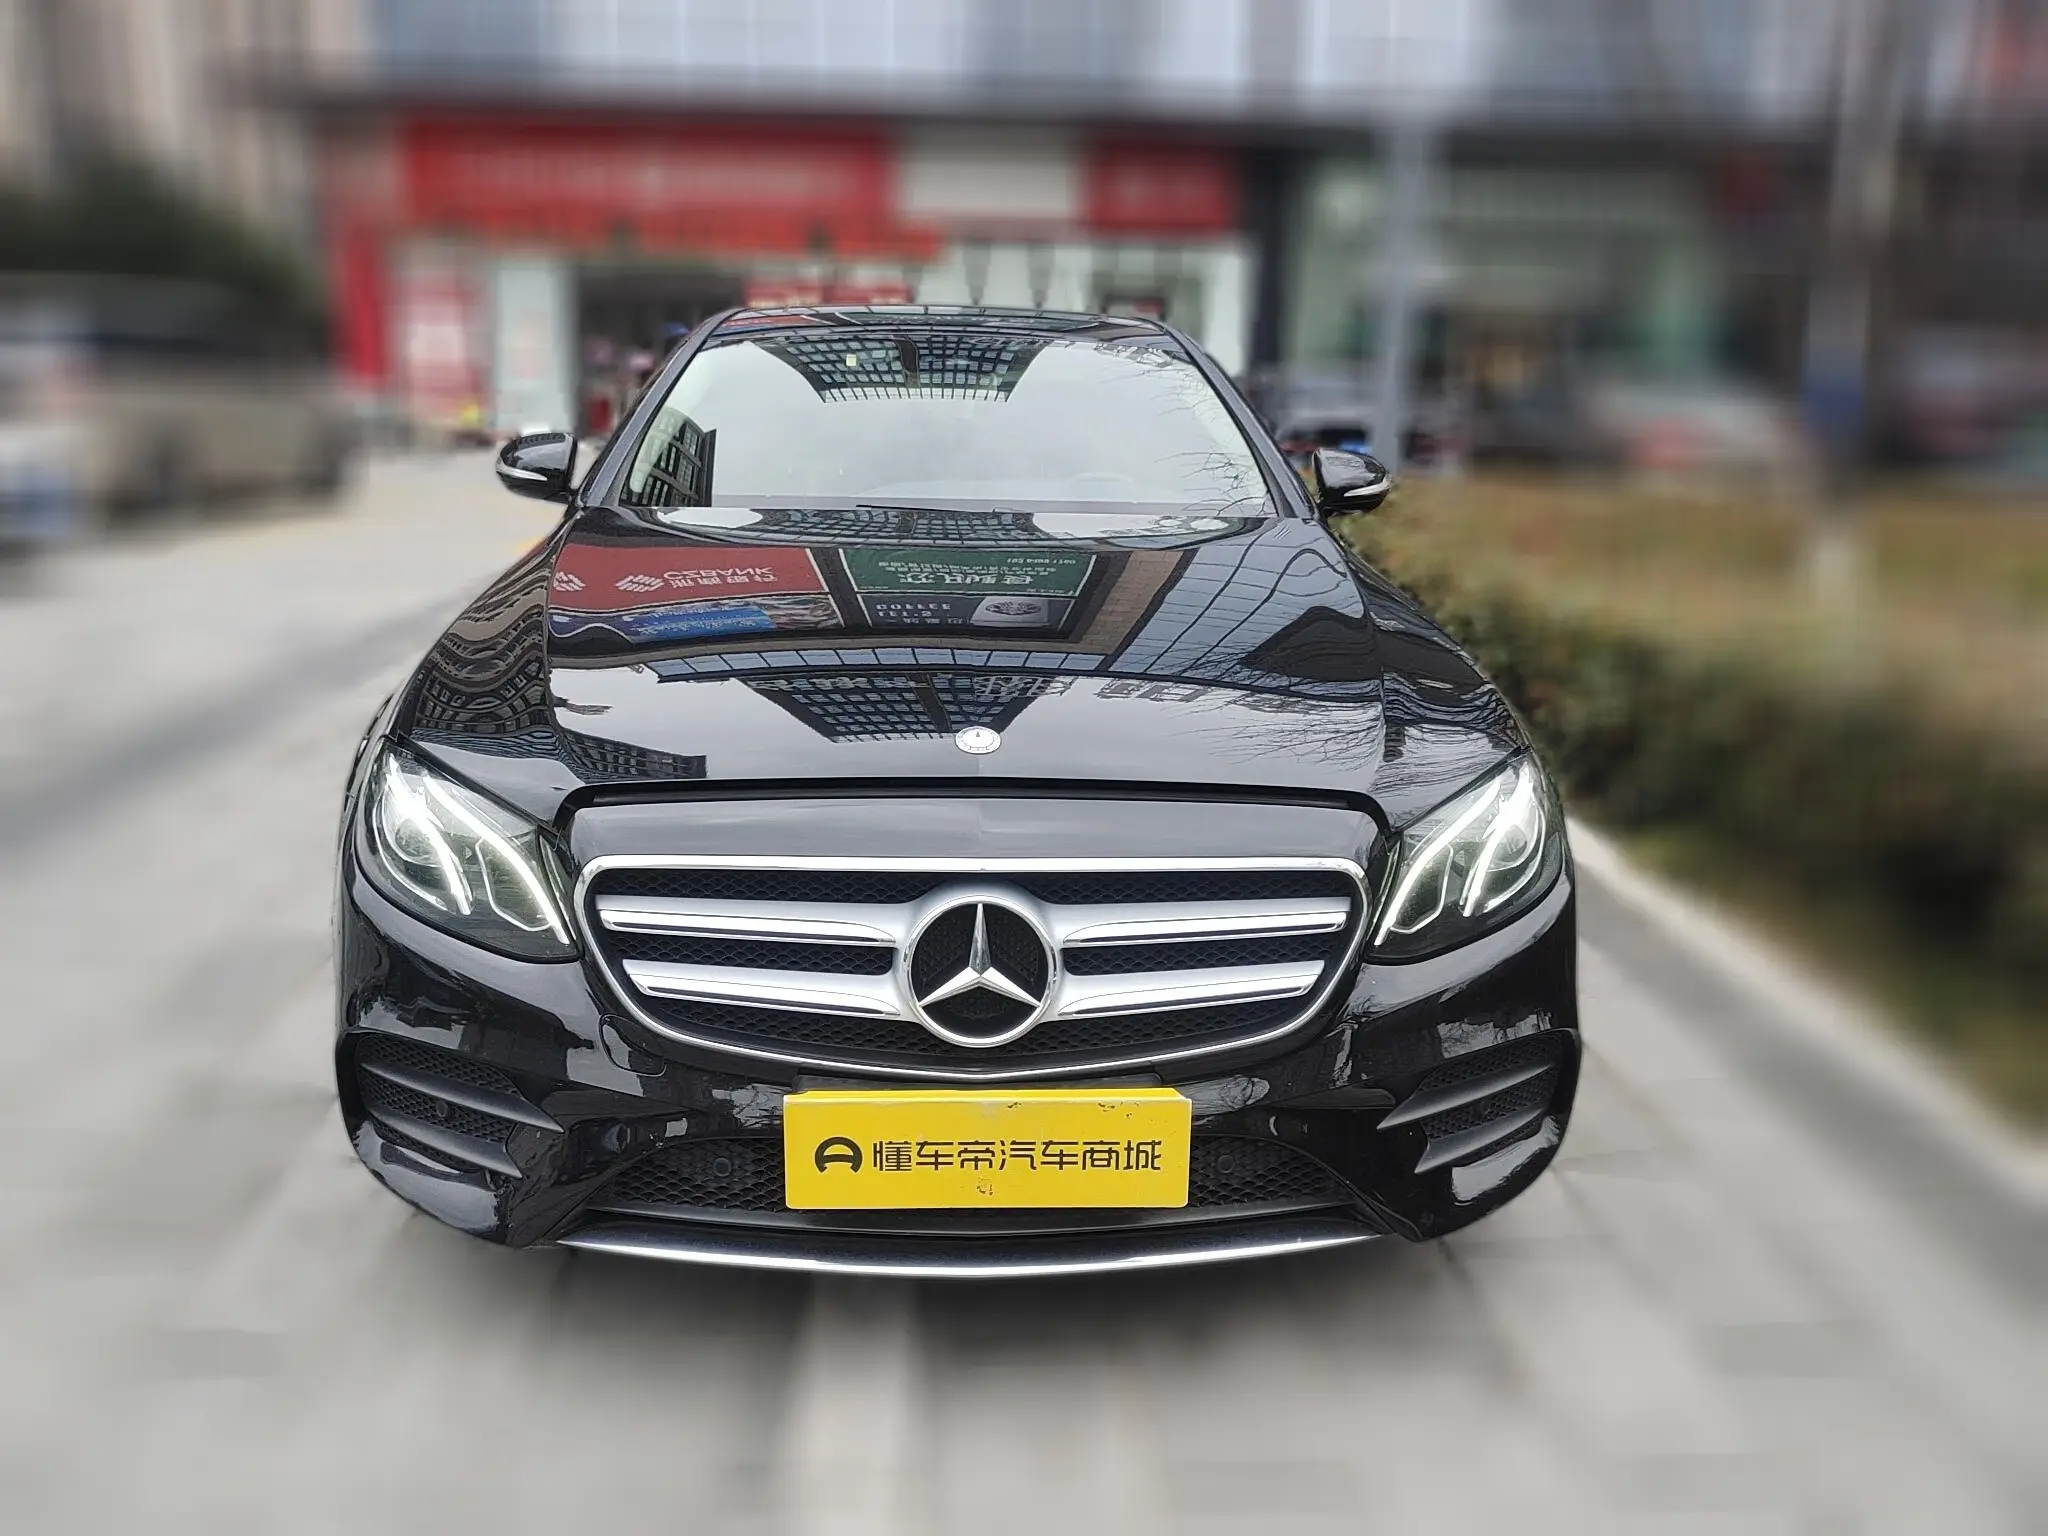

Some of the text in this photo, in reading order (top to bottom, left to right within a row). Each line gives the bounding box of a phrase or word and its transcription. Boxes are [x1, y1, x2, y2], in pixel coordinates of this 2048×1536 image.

[872, 1139, 1162, 1172] 懂车帝汽车商城
